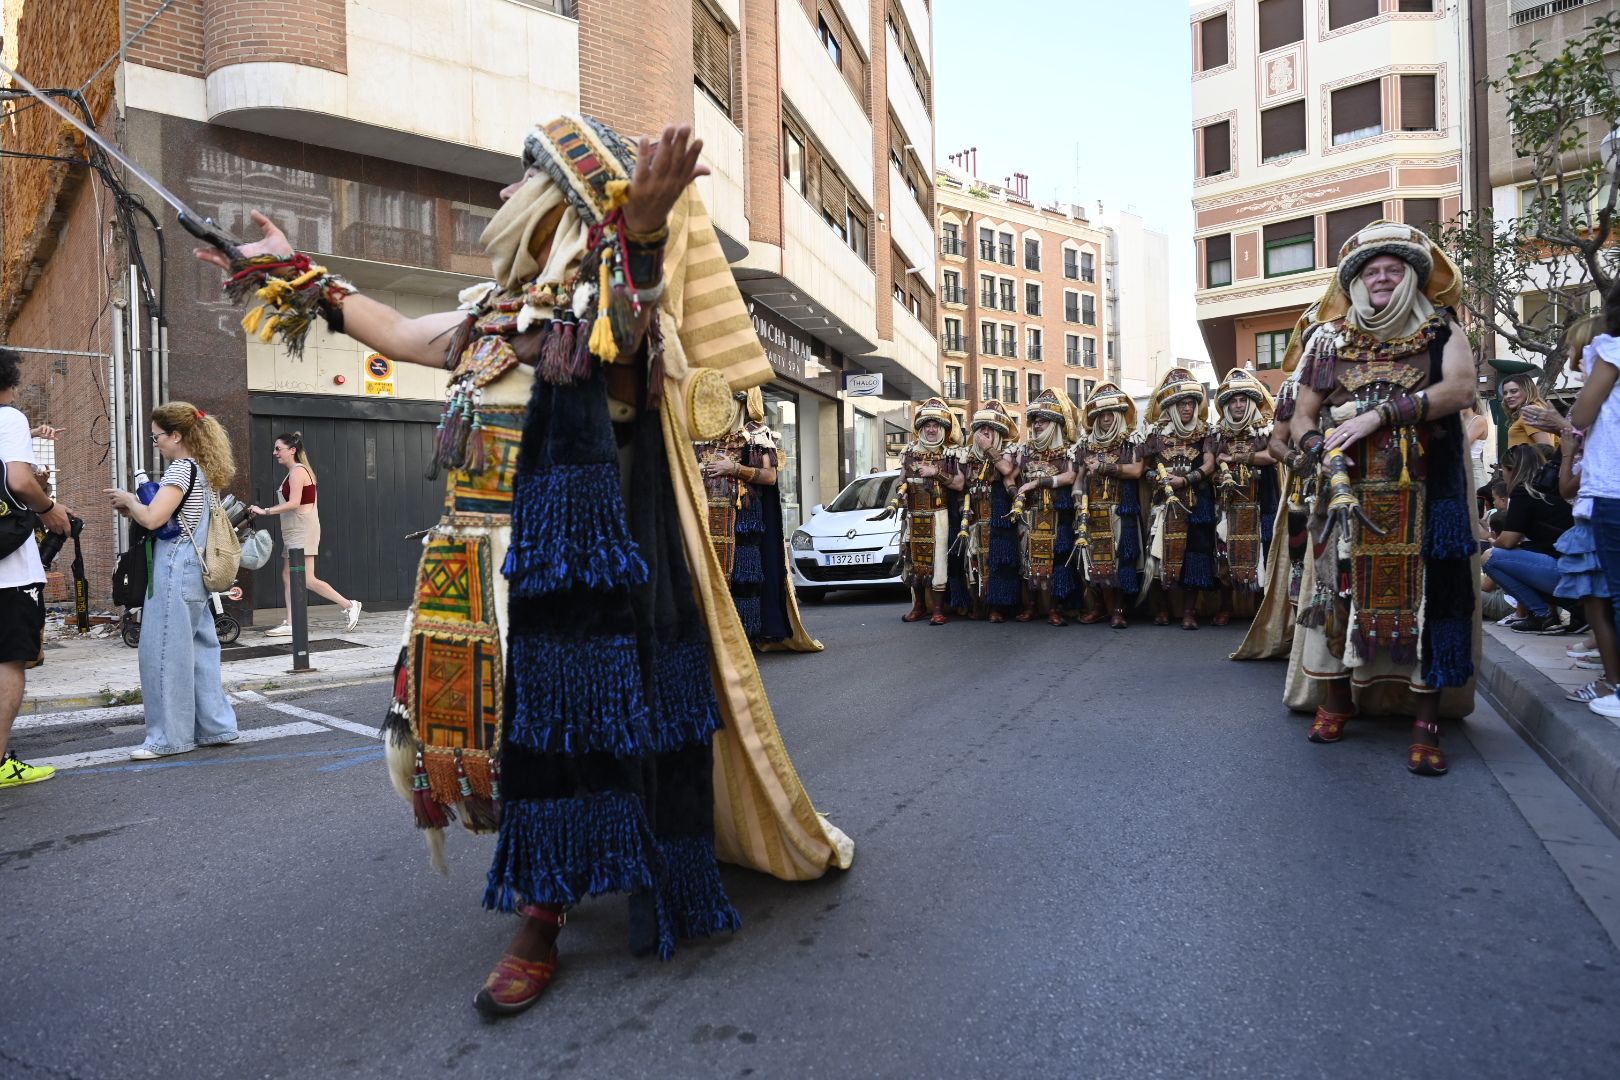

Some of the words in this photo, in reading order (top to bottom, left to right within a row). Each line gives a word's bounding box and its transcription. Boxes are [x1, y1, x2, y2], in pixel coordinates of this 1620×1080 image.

[752, 314, 787, 349] ONCHA
[789, 335, 812, 362] JUAN
[788, 360, 800, 374] SPA
[853, 379, 878, 387] THALGO
[832, 554, 853, 565] 1372
[854, 553, 872, 564] GTF
